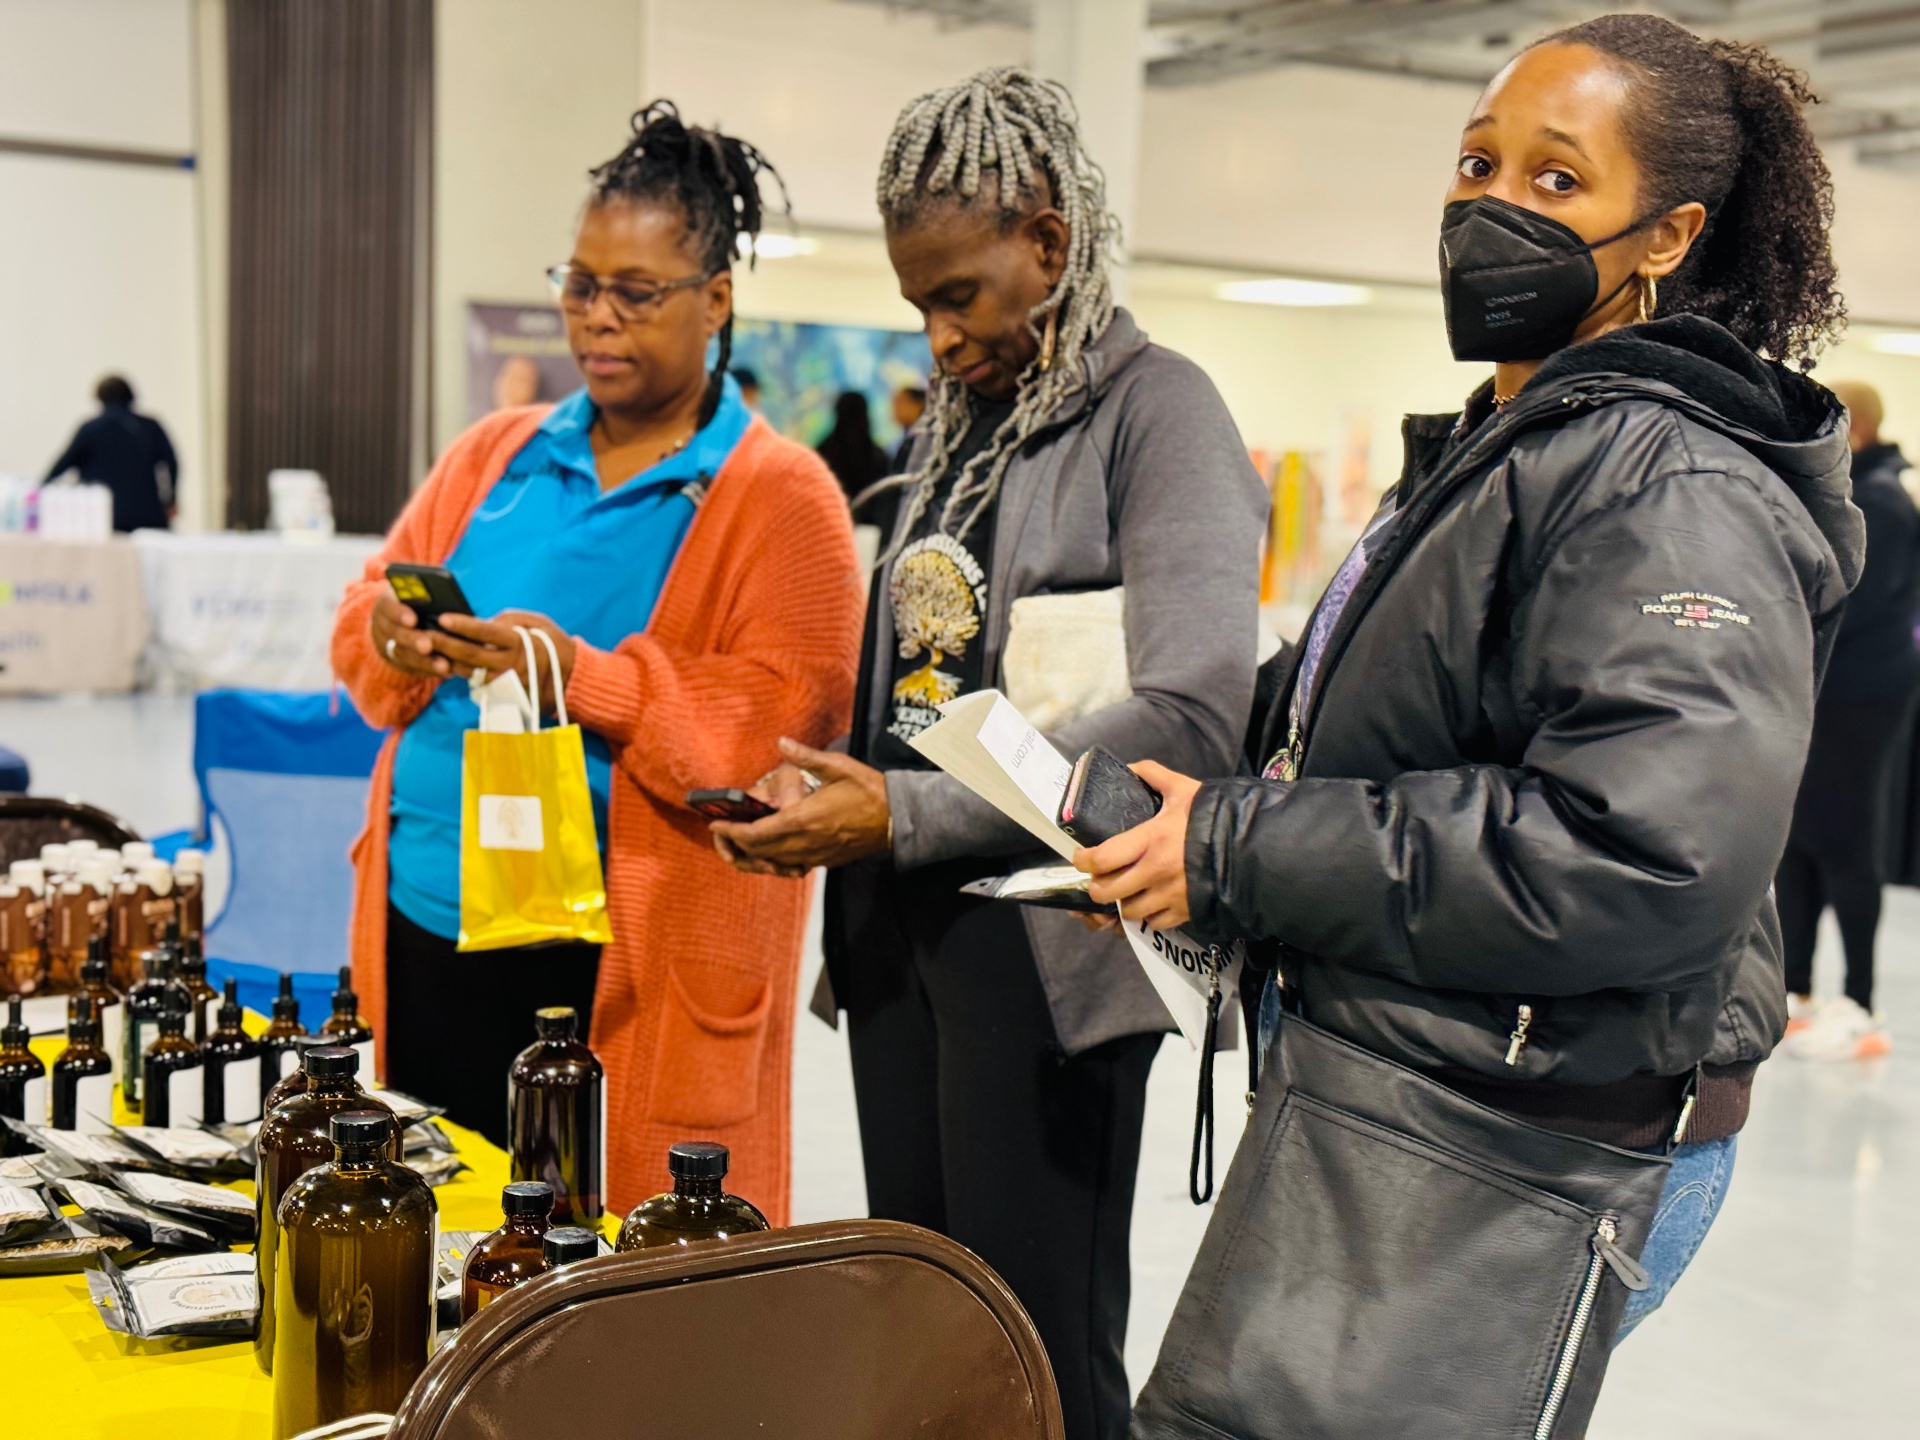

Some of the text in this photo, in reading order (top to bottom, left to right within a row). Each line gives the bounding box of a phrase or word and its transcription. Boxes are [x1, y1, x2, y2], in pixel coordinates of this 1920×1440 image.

[1660, 591, 1695, 603] RALPH
[1641, 604, 1751, 625] POLO JEANS
